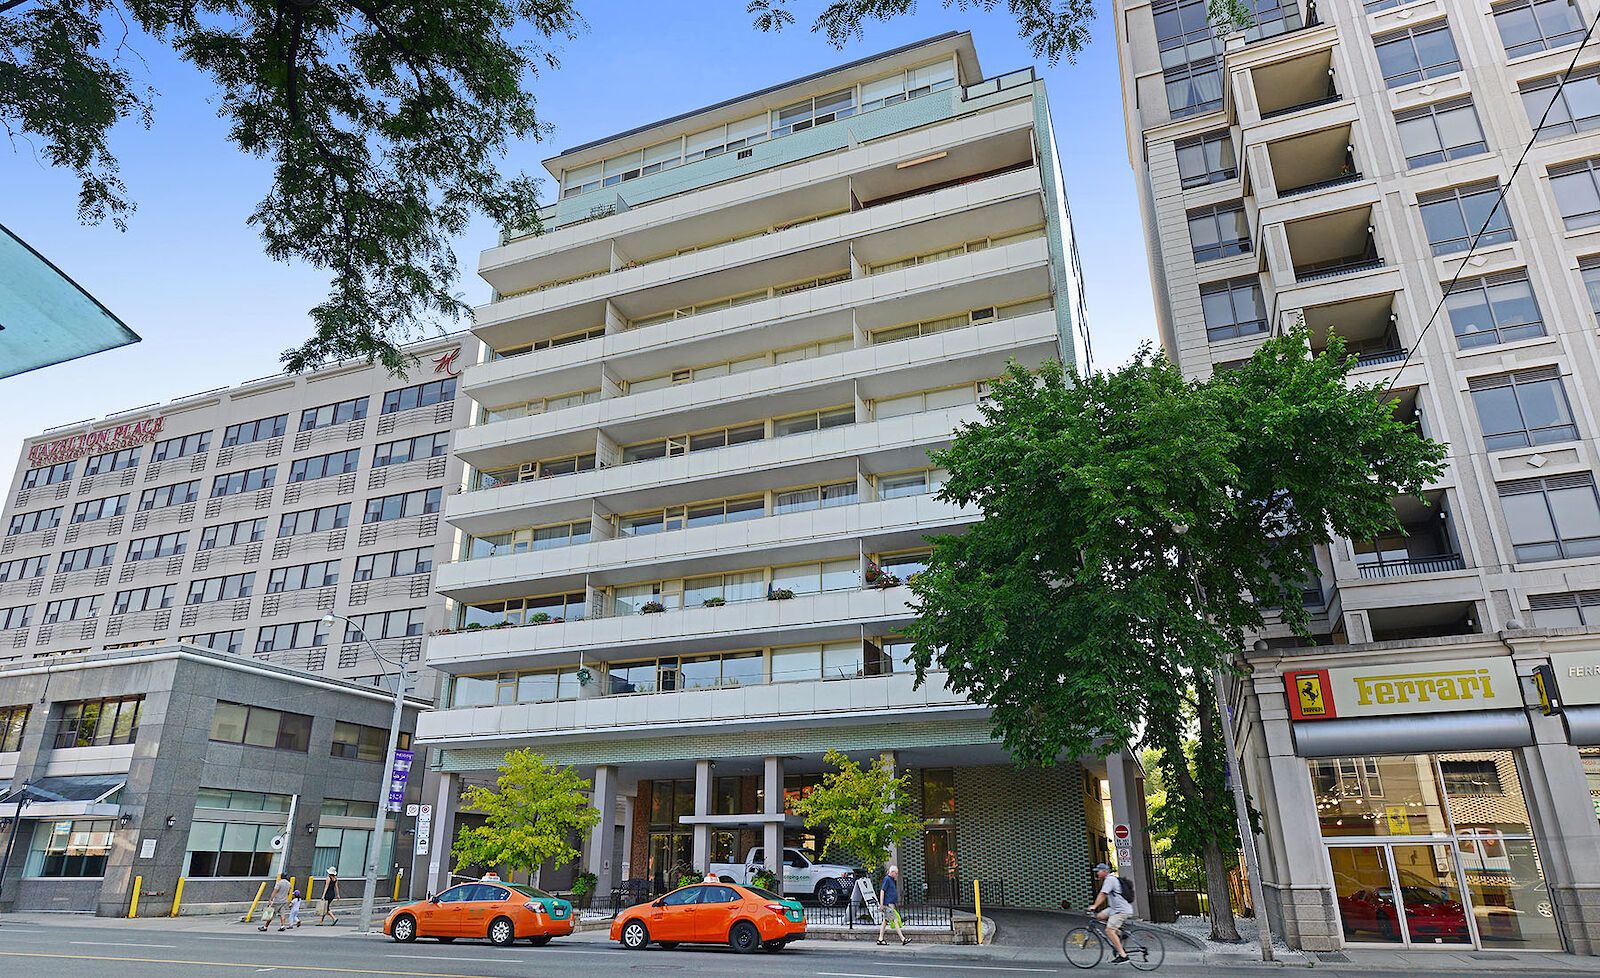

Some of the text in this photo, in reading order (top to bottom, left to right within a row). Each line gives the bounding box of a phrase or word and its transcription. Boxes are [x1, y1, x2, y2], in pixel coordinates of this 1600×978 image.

[27, 416, 165, 460] HAZELTON PLACE
[1353, 669, 1495, 705] Ferrari
